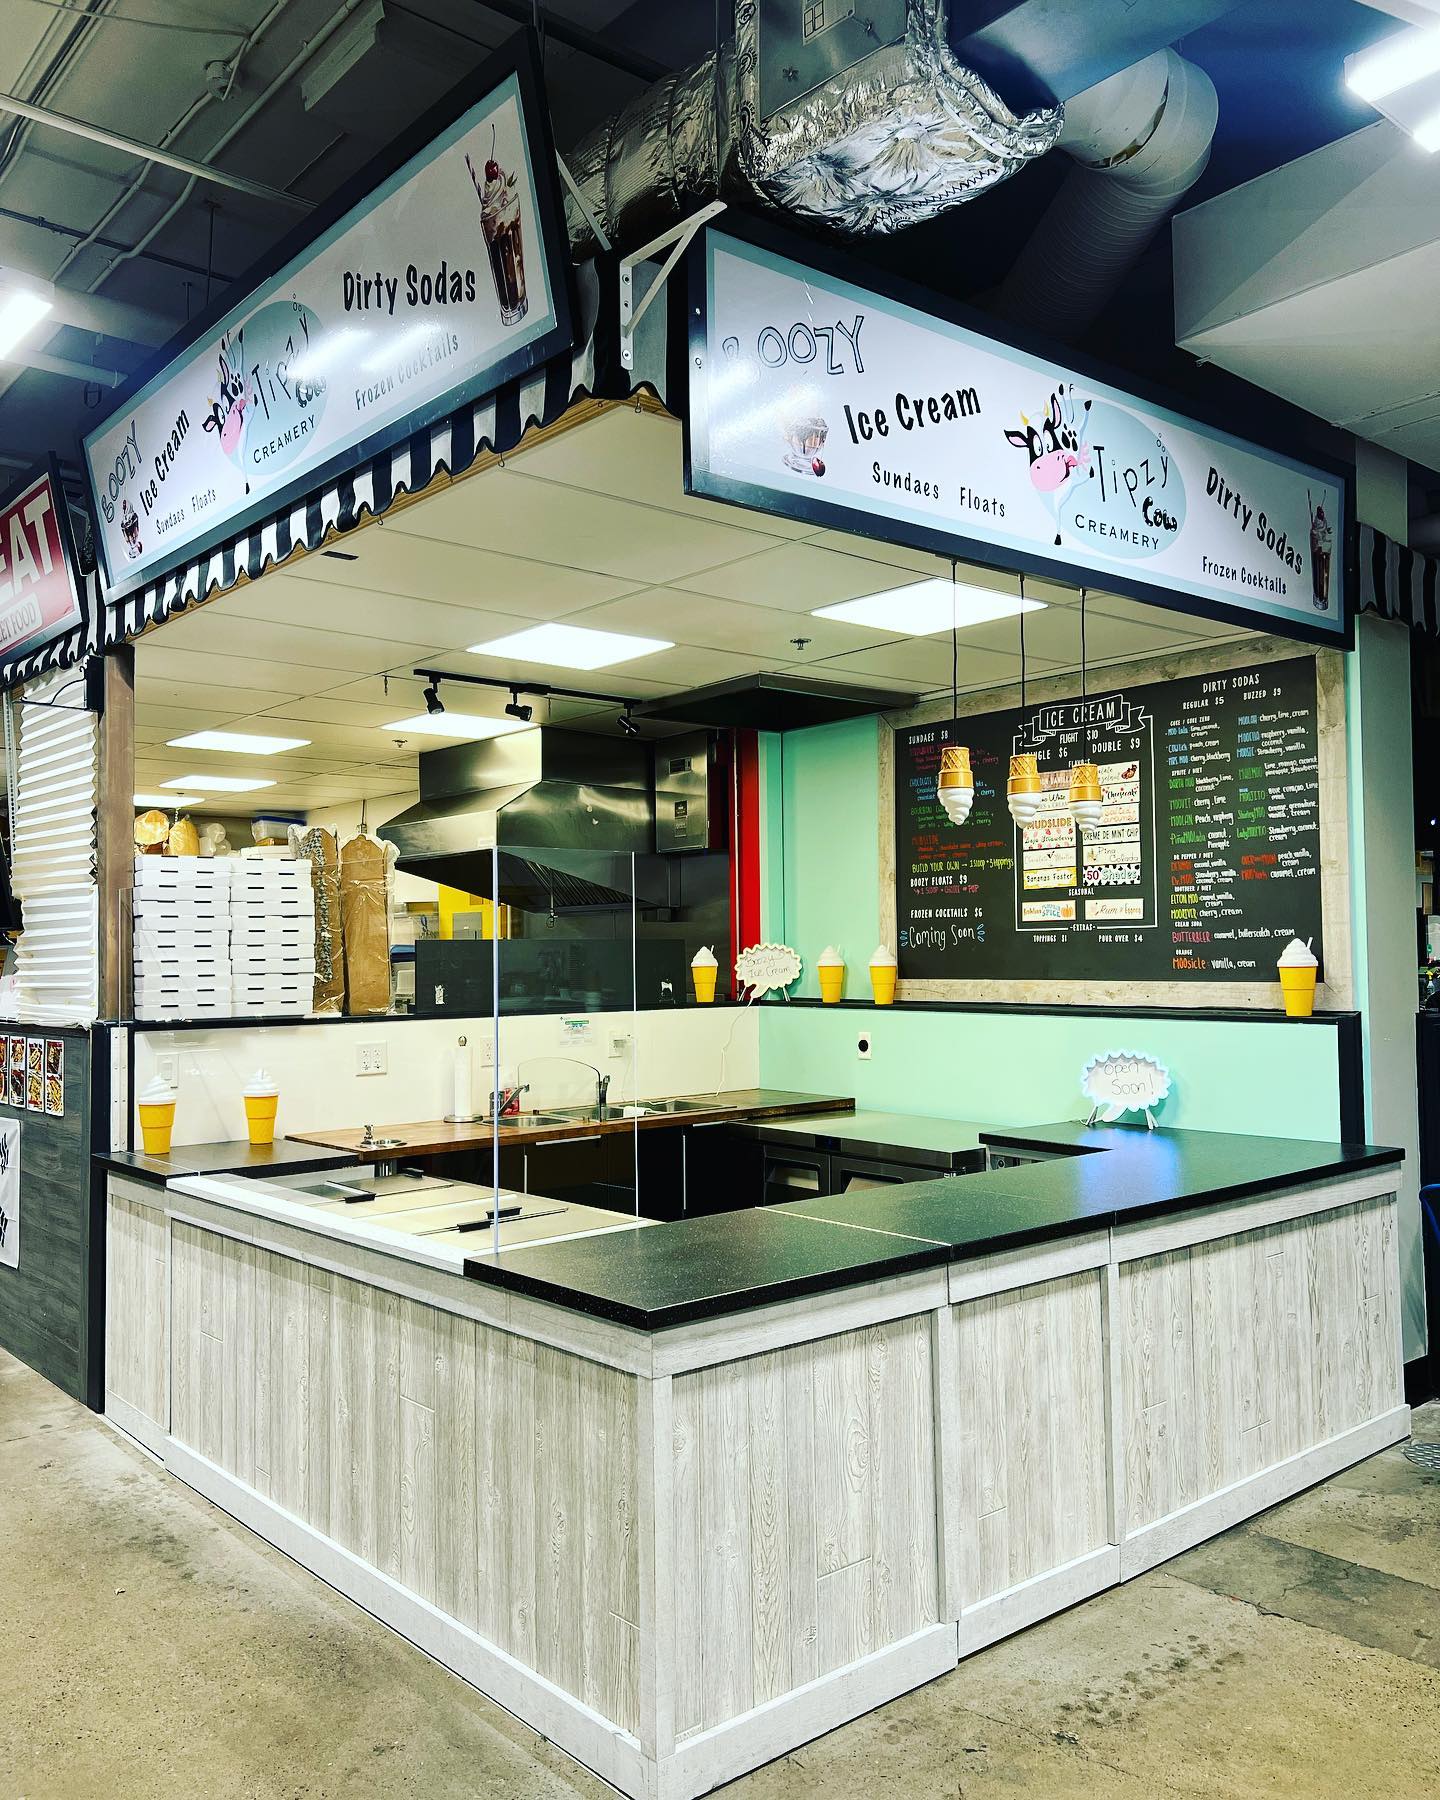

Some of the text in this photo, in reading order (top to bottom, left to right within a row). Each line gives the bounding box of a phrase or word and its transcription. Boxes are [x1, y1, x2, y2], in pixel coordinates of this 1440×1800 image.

[343, 260, 476, 316] Dirty Sodas
[355, 332, 459, 411] Frozen Cocktails
[843, 386, 981, 444] Ice Cream
[253, 414, 316, 464] CREAMERY
[139, 409, 190, 516] Ice Cream
[101, 420, 142, 523] BOOZY
[872, 461, 1006, 518] Sundaes Floats
[156, 488, 217, 535] Sundaes Floats
[1142, 496, 1178, 532] Cow
[1206, 467, 1303, 575] Dirty Sodas
[1074, 512, 1159, 550] CREAMERY
[1202, 555, 1287, 596] Frozen Cocktails
[1203, 673, 1260, 693] DIRTY SODAS
[1243, 688, 1281, 700] BUZZED $9
[1183, 696, 1224, 710] REGULAR $5
[1046, 701, 1115, 728] ICE CREAM
[908, 732, 934, 745] SUNDAES
[1059, 729, 1099, 744] FLIGHT $10
[1058, 747, 1068, 758] $6
[1092, 737, 1140, 754] DOUBLE $9
[1107, 788, 1138, 800] Cheesecake
[1102, 830, 1109, 839] DE
[1111, 828, 1125, 838] MINT
[911, 863, 928, 873] BUILD
[929, 861, 944, 872] YOUR
[946, 861, 960, 871] OWN
[1086, 869, 1138, 880] 50 Shades
[910, 874, 968, 887] BOOZY FLOATS $9
[1068, 887, 1095, 896] SEASONAL
[910, 907, 983, 918] FROZEN COCKTAILS $6
[909, 924, 975, 951] Coming Soon
[1098, 935, 1113, 943] POUR
[1172, 930, 1212, 944] BUTTERBEER
[1274, 928, 1295, 937] cream
[1236, 959, 1256, 968] cream
